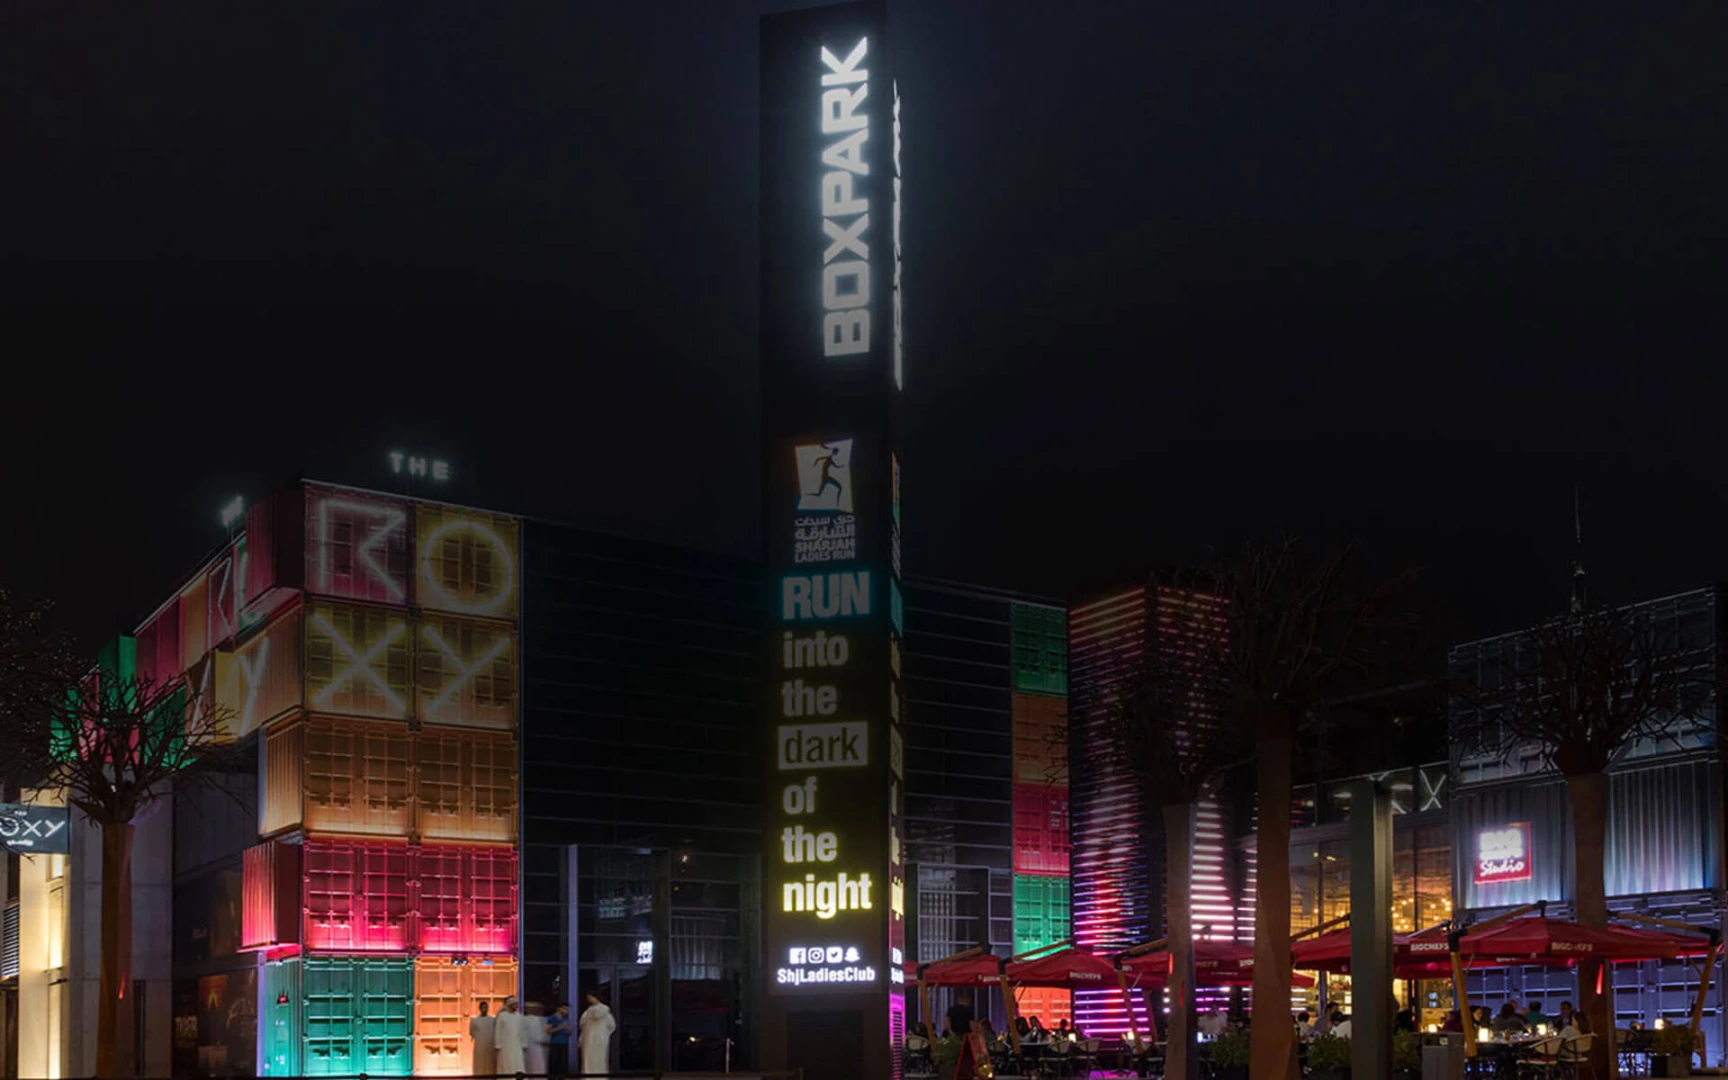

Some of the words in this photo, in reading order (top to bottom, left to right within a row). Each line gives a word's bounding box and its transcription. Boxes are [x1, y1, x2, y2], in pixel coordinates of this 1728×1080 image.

[820, 36, 870, 357] BOXPARK
[389, 451, 450, 481] THE
[795, 538, 856, 553] SHARJAH
[795, 551, 830, 563] LADIES
[832, 549, 856, 560] RUN
[782, 571, 871, 621] RUN
[783, 630, 850, 669] into
[781, 678, 839, 718] the
[785, 728, 859, 765] dark
[782, 775, 818, 816] of
[781, 823, 839, 864] the
[1480, 858, 1525, 877] Studio
[782, 872, 873, 920] night
[777, 966, 876, 985] ShjLadiesClub
